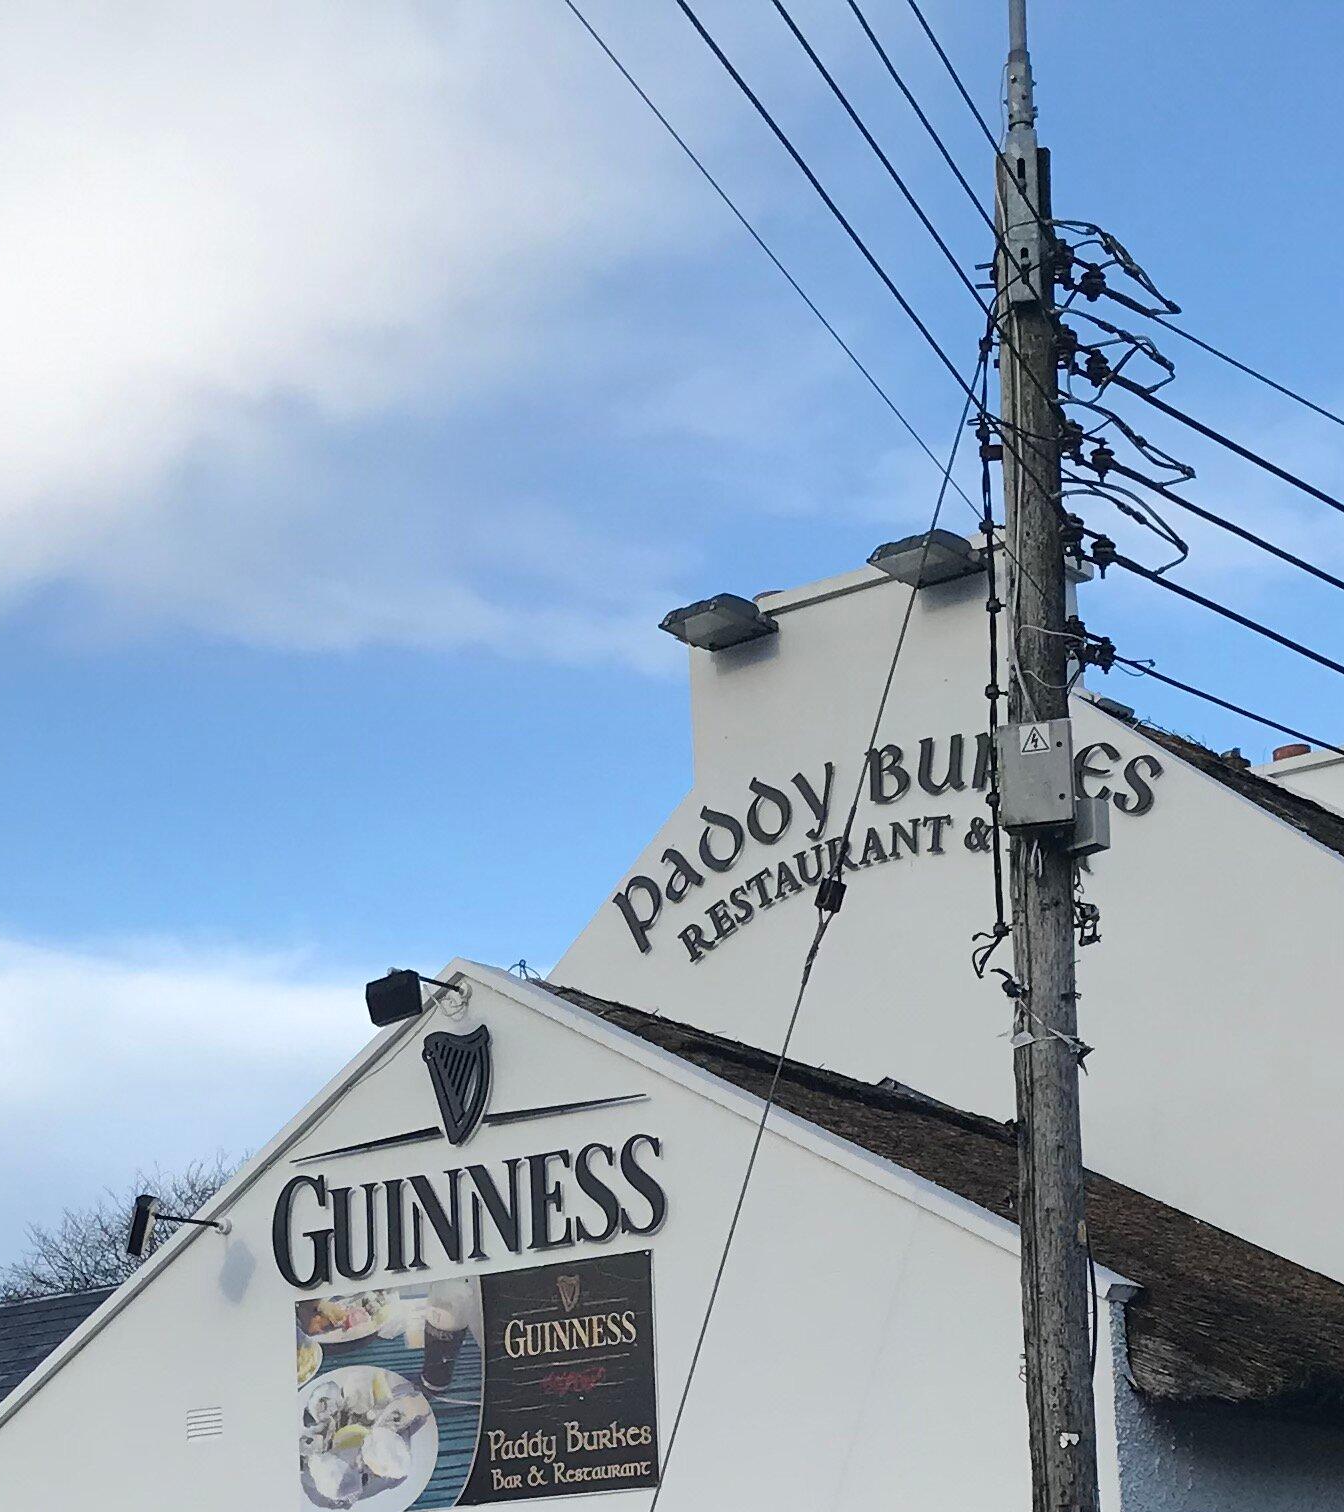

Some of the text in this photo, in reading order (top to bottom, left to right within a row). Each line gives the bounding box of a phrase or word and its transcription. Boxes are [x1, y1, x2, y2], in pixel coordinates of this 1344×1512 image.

[678, 814, 951, 963] RESTAURANT
[272, 1133, 668, 1290] GUINNESS
[504, 1310, 637, 1359] GUINNESS
[488, 1421, 652, 1463] Paddy Burkes
[491, 1461, 652, 1490] Bar & Restaurant
